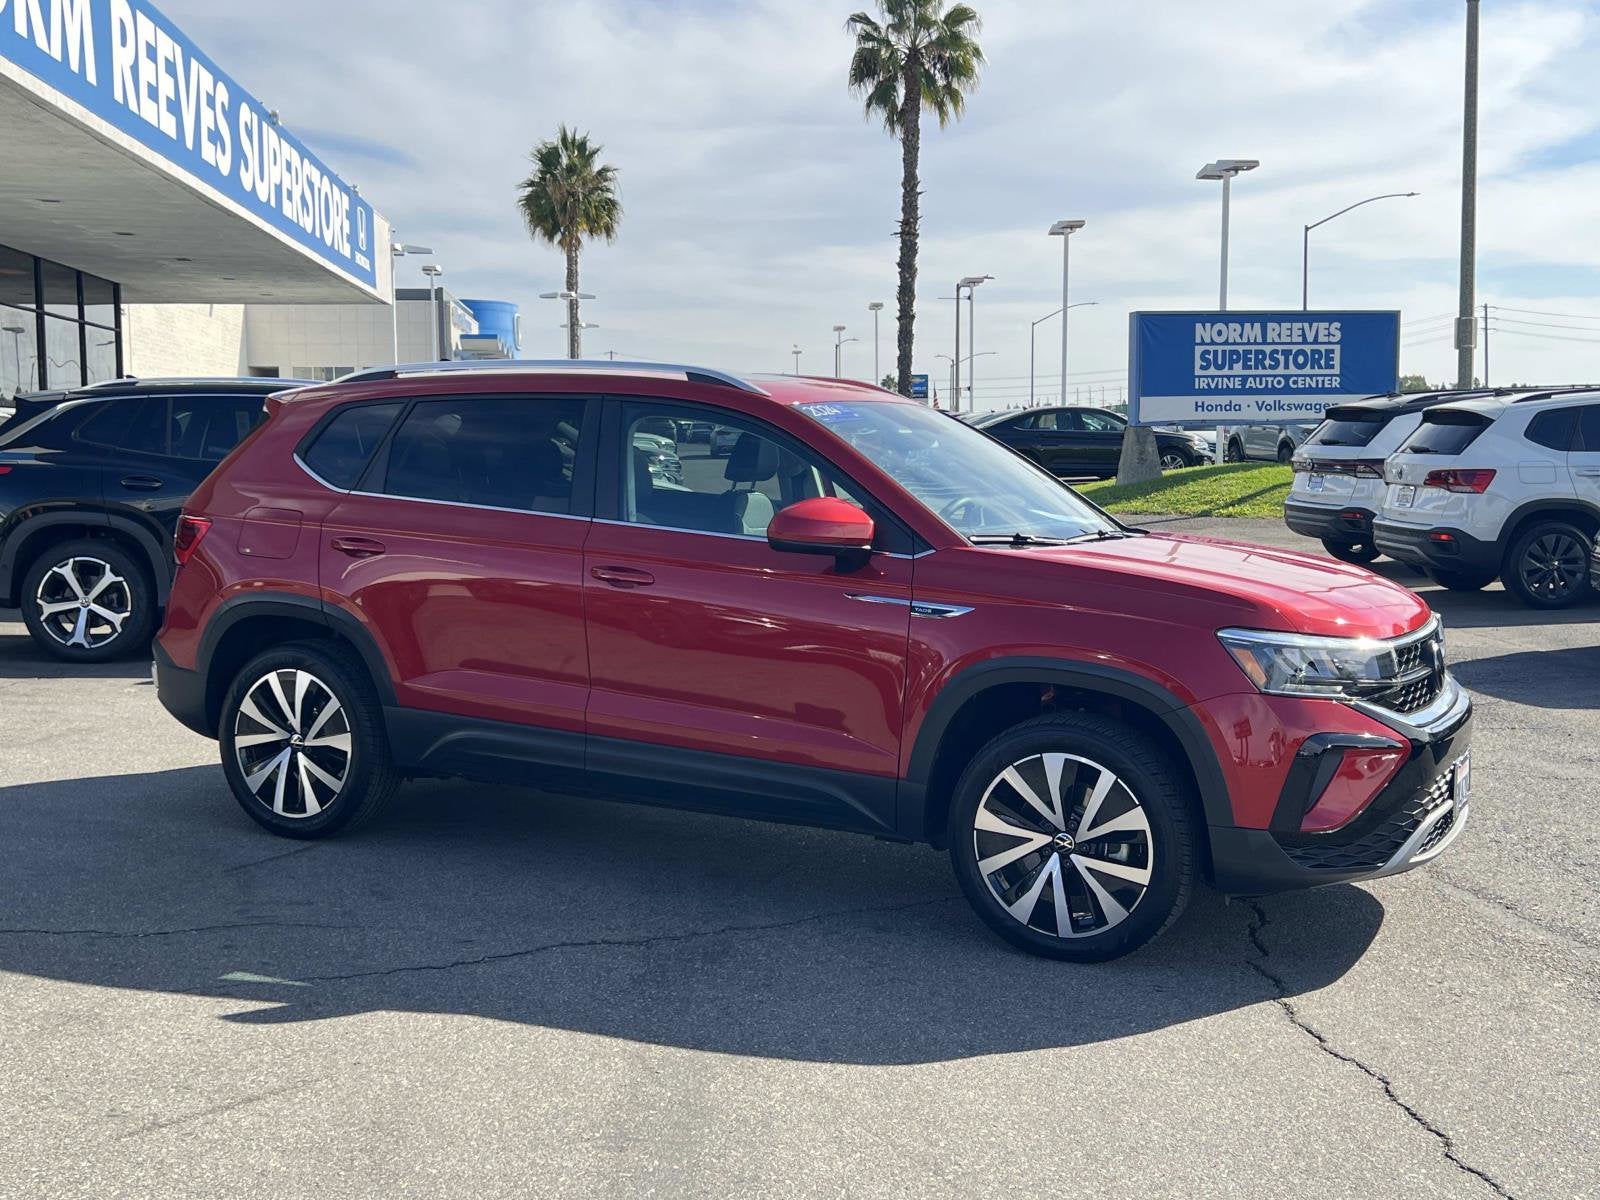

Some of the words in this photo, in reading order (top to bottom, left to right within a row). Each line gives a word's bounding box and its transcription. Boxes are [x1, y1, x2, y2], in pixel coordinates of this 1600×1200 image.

[110, 0, 232, 177] REEVES
[238, 101, 351, 260] SUPERSTORE
[1195, 322, 1263, 344] NORM
[1266, 322, 1342, 343] REEVES
[1199, 348, 1336, 371] SUPERSTORE
[1194, 377, 1242, 390] IRVINE
[1245, 376, 1285, 389] AUTO
[1288, 376, 1341, 389] CENTER
[1194, 400, 1242, 413] Honda
